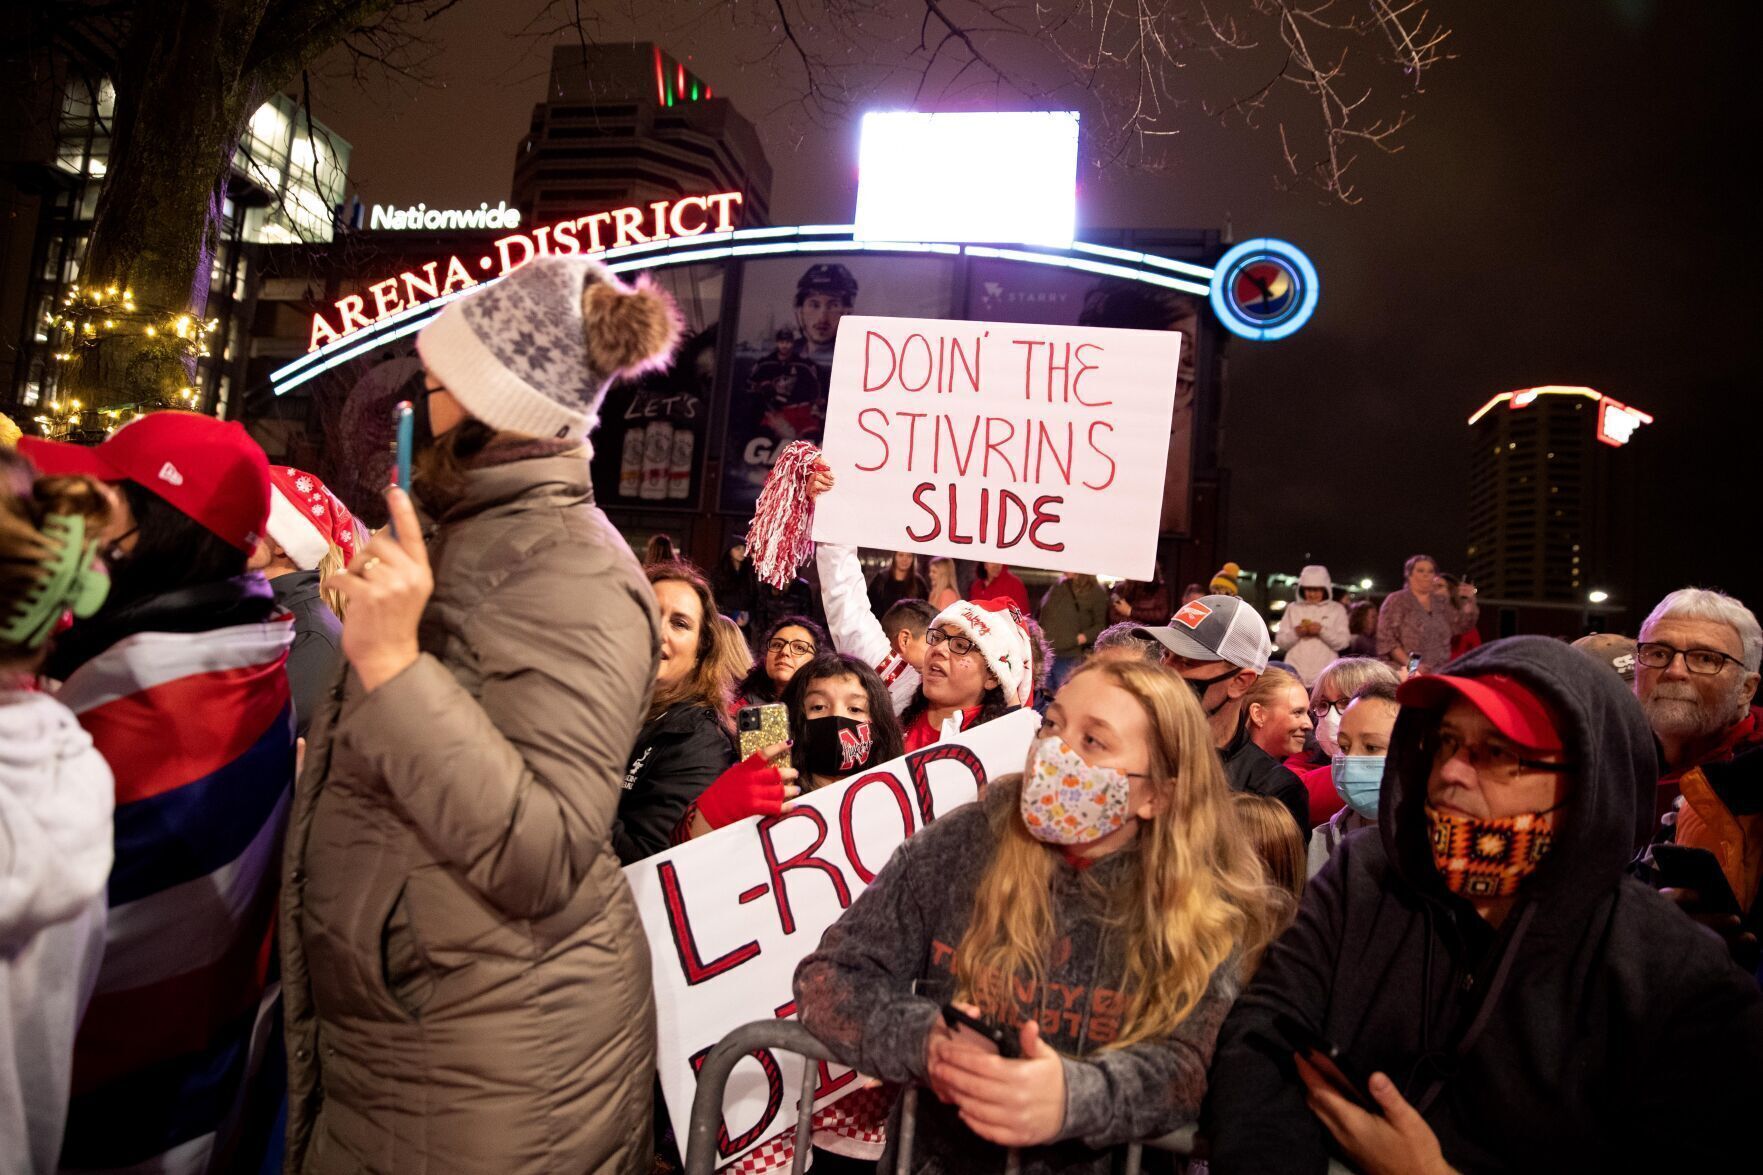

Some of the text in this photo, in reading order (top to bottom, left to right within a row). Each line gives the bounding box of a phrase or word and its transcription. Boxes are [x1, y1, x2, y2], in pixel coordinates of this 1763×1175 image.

[370, 201, 521, 230] Nationwide
[307, 192, 742, 353] ARENA DISTRICT
[624, 392, 699, 420] LET'S
[864, 331, 1112, 407] DOIN' THE
[855, 407, 1116, 490] STIVRINS
[905, 481, 1065, 552] SLIDE
[656, 743, 988, 986] L-ROD
